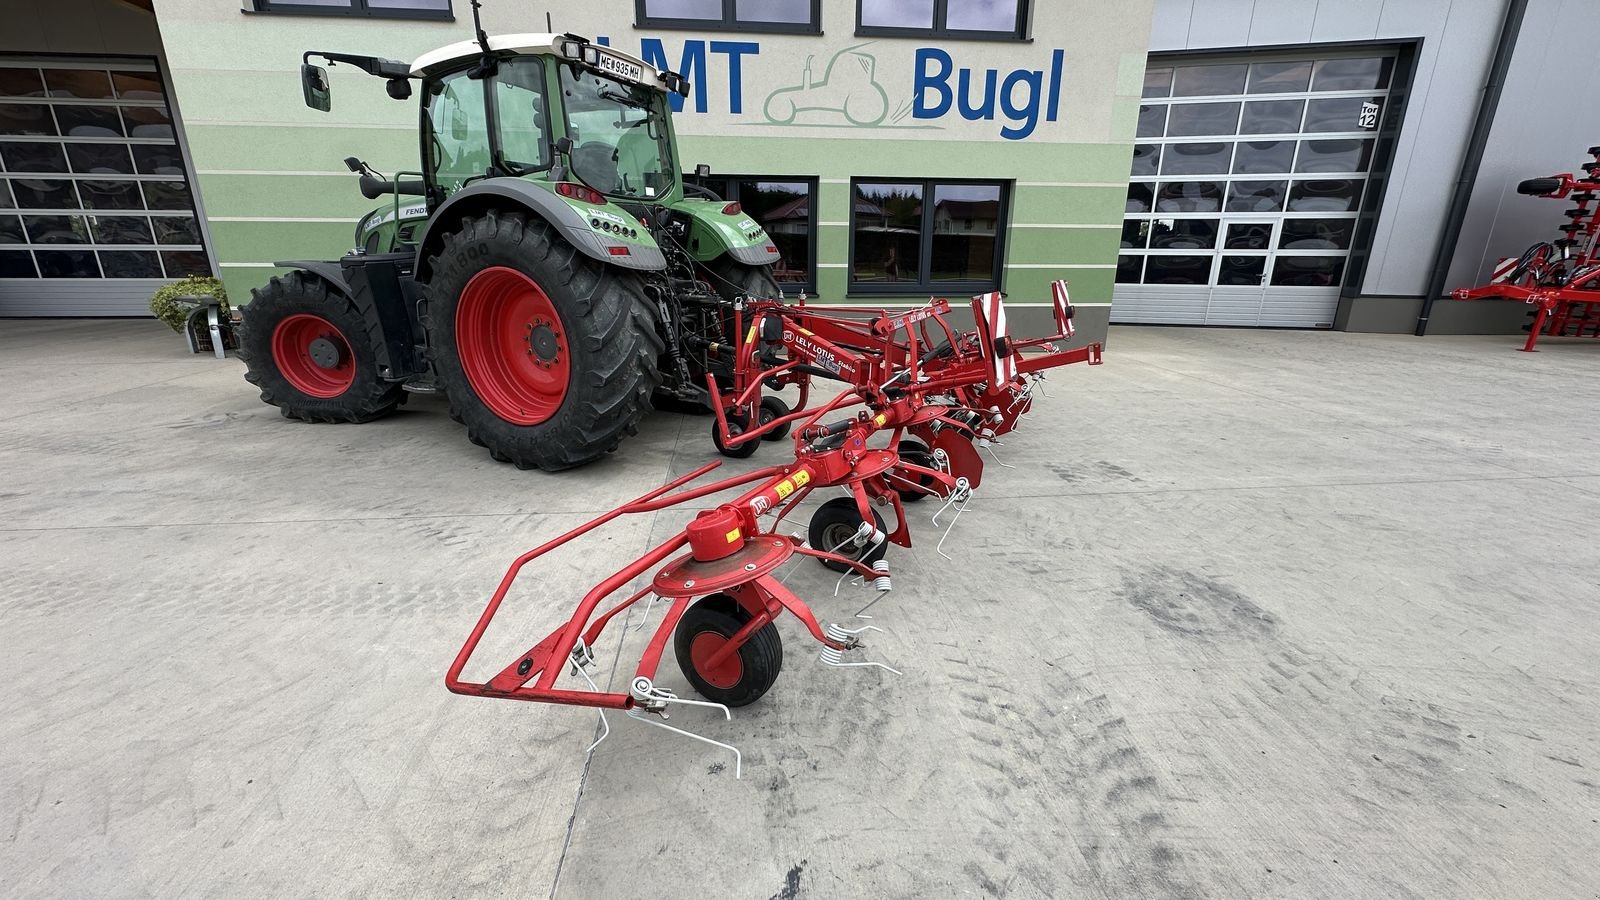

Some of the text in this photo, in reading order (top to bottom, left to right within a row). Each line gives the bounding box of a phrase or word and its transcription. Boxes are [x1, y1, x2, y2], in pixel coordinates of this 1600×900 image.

[601, 55, 611, 70] ME
[615, 60, 629, 76] 935
[597, 36, 1065, 141] MT Bugl
[1360, 114, 1376, 126] 12
[1362, 106, 1378, 114] Tor
[795, 335, 812, 349] LELY
[813, 344, 835, 361] LOTUS
